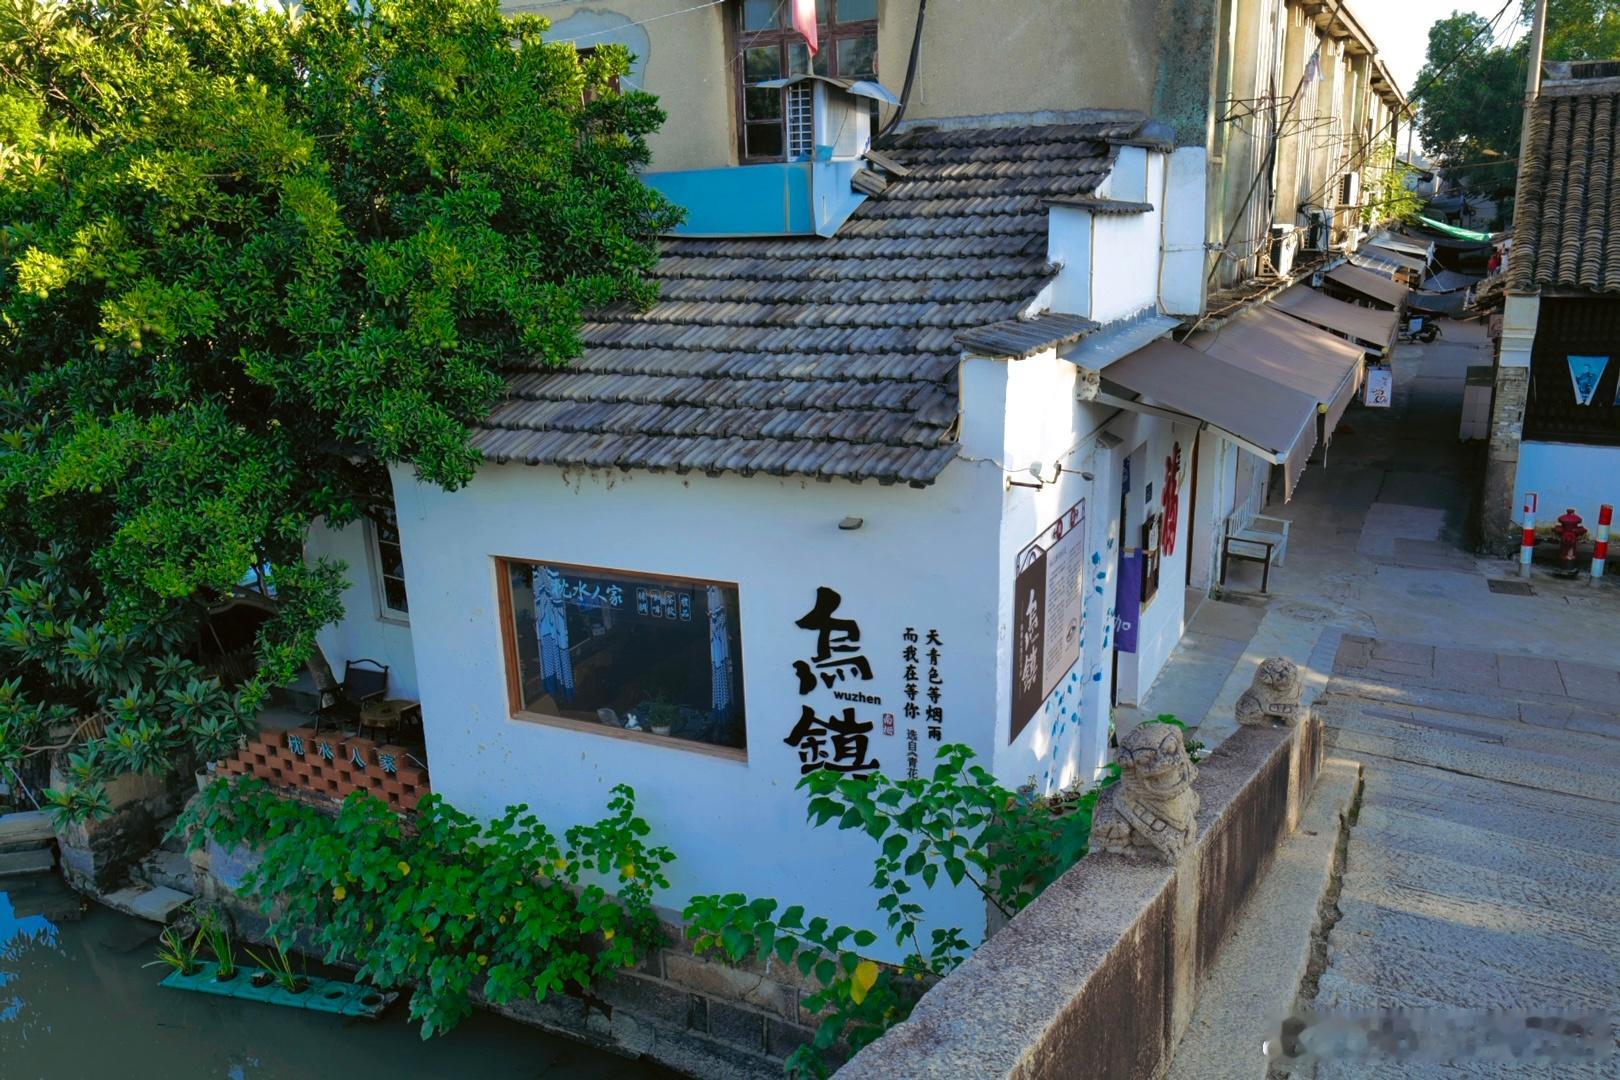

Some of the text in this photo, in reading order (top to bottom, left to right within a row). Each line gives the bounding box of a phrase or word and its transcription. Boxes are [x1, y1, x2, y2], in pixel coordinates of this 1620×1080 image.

[834, 690, 882, 706] wuzhen
[902, 627, 920, 719] 而我在等你
[926, 629, 943, 742] 天青色等烟雨
[288, 735, 399, 773] 枕水人家
